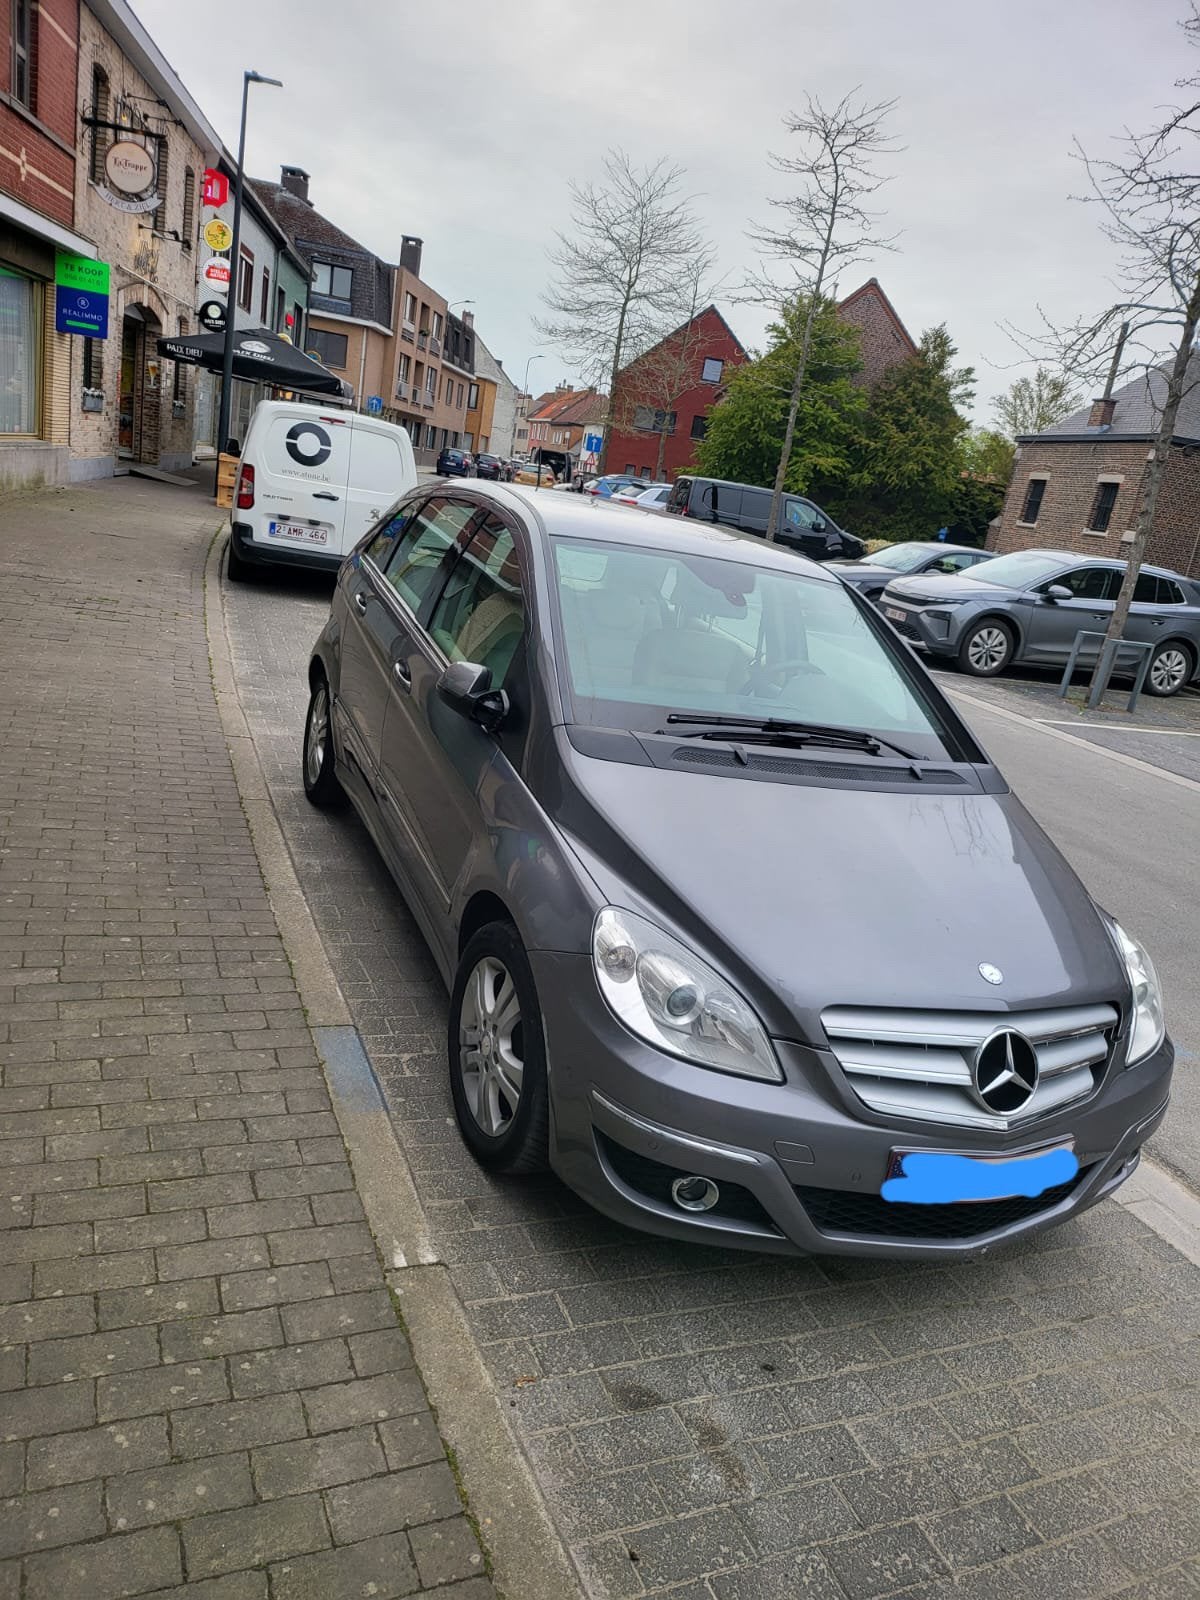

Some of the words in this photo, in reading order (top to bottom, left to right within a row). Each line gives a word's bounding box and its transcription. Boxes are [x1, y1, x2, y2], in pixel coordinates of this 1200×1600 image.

[119, 159, 148, 172] Trappe
[64, 262, 75, 272] TE
[78, 265, 104, 277] KOOP
[62, 307, 103, 322] REALIMMO
[166, 343, 184, 354] PAIX
[185, 346, 203, 358] DIEU
